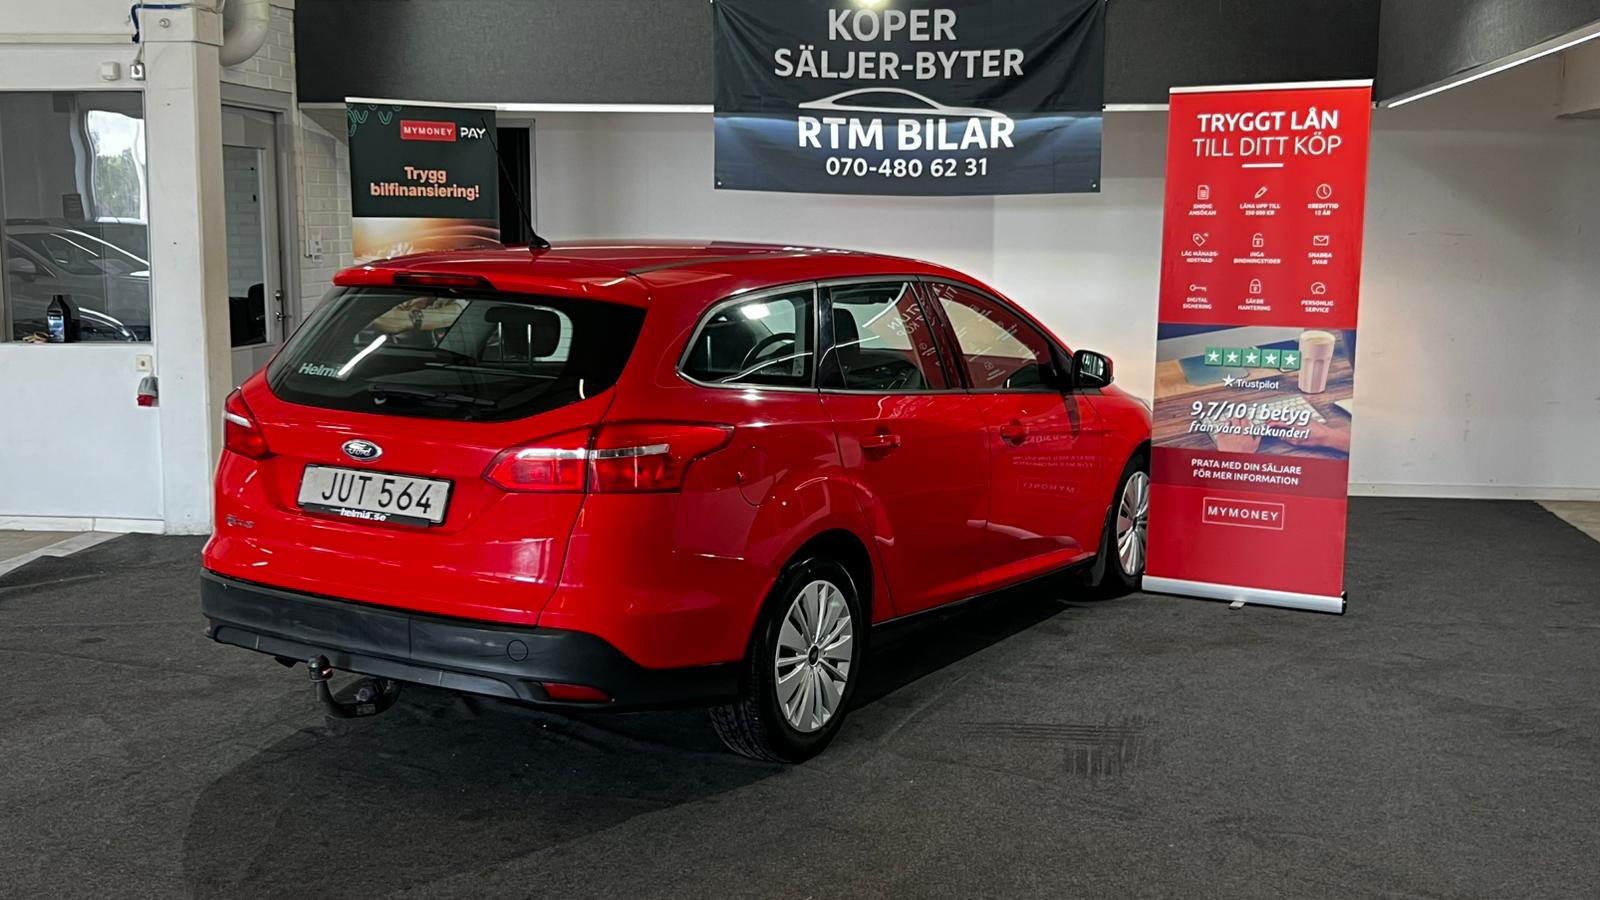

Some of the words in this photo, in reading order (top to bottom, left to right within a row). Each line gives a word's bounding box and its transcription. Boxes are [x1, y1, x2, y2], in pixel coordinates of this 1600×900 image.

[774, 45, 1025, 80] SÄLJER-BYTER
[1197, 111, 1286, 133] TRYGGT
[1290, 106, 1339, 131] LÅN
[403, 127, 453, 136] MYMONEY
[460, 127, 486, 139] PAY
[798, 116, 884, 151] RTM
[897, 116, 1016, 151] BILAR
[1192, 138, 1234, 157] TILL
[1239, 136, 1289, 157] DITT
[1294, 131, 1342, 155] KÖP
[404, 166, 447, 183] Trygg
[826, 158, 923, 178] 070-480
[929, 158, 958, 177] 62
[964, 158, 988, 177] 31
[370, 182, 480, 200] bilfinansiering!
[298, 362, 342, 378] Helmi
[1237, 379, 1280, 391] Trustpilot
[1191, 401, 1247, 420] 9,7/10
[1250, 403, 1257, 420] i
[1260, 403, 1312, 426] betyg
[1189, 420, 1213, 433] från
[1216, 422, 1241, 434] våra
[1243, 424, 1311, 439] slutkunder!
[1191, 458, 1221, 468] PRATA
[1221, 461, 1242, 470] MED
[1243, 463, 1260, 471] DIN
[1261, 462, 1302, 475] SÄLJARE
[1193, 468, 1212, 479] FÖR
[1212, 471, 1232, 480] MER
[1234, 473, 1299, 485] INFORMATION
[322, 472, 373, 505] JUT
[378, 478, 433, 514] 564
[340, 508, 387, 522] helmia.se
[1207, 505, 1279, 521] MYMONEY
